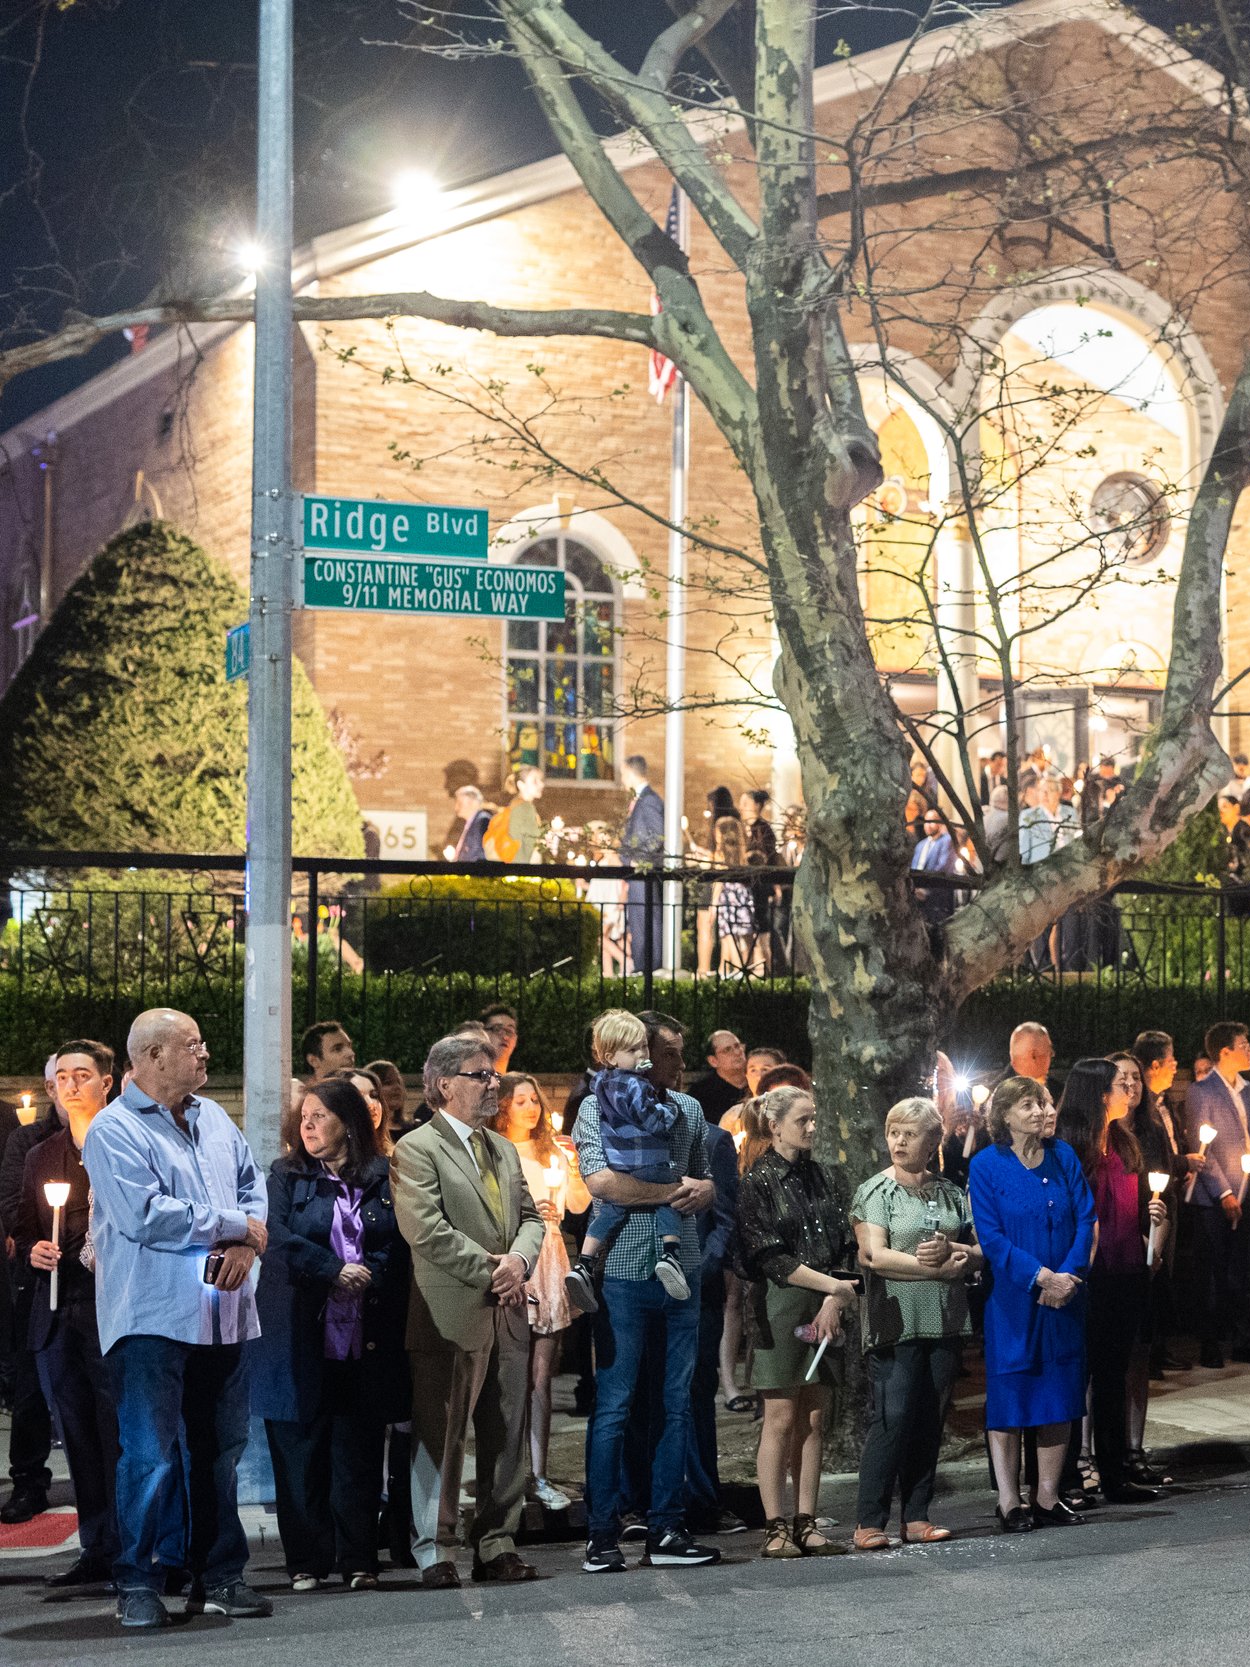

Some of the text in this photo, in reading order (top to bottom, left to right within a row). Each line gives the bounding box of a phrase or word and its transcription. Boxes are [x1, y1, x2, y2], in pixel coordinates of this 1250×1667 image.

[311, 501, 478, 551] Ridge Blvd
[314, 560, 556, 594] CONSTANTINE "GUS" ECONOMOS
[343, 584, 529, 614] 9/11 MEMORIAL WAY
[373, 825, 417, 849] 65
